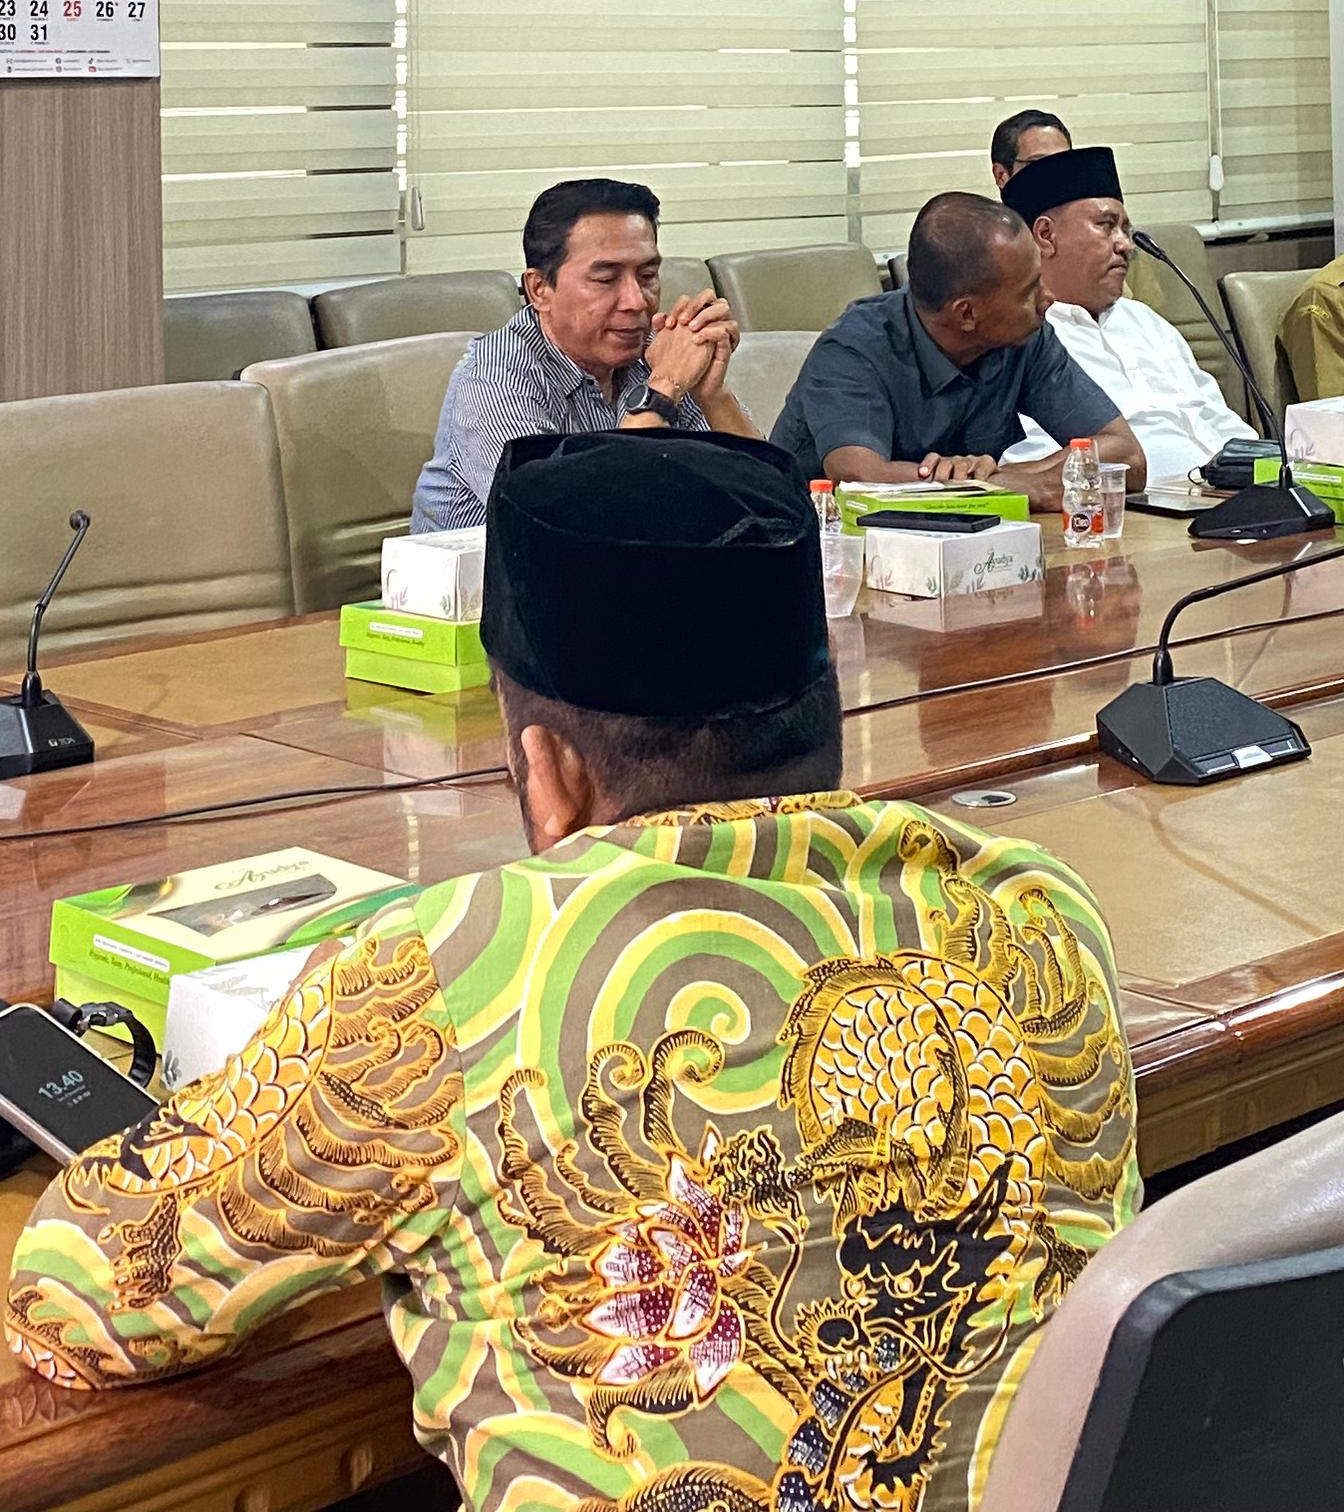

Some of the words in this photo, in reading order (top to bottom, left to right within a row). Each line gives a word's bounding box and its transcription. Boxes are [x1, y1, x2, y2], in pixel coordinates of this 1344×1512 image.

[29, 0, 48, 17] 24
[63, 0, 82, 17] 25
[95, 1, 114, 17] 26
[127, 2, 145, 18] 27
[30, 24, 47, 40] 31
